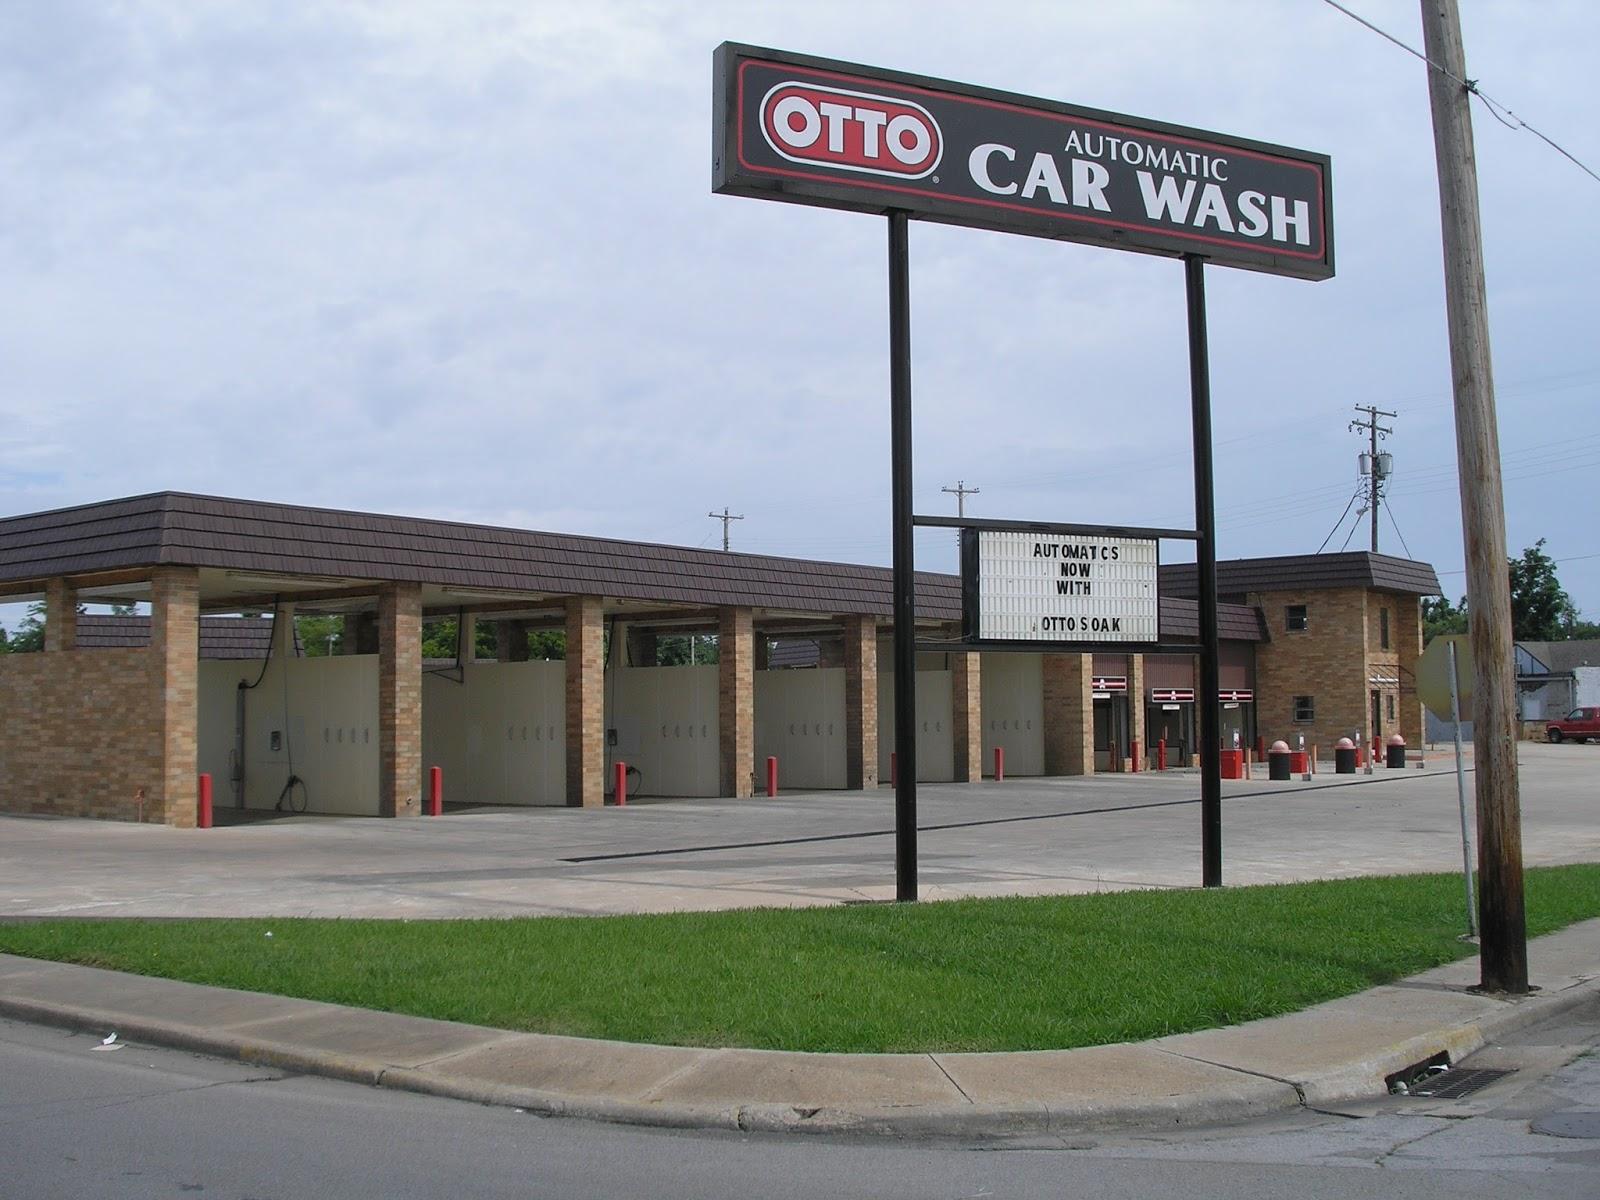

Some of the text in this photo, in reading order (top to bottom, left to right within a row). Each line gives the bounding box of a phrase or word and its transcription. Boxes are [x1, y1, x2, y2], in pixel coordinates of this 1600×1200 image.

[772, 96, 931, 165] OTTO
[1064, 130, 1229, 181] AUTOMATIC
[968, 143, 1311, 246] CAR WASH
[1056, 580, 1091, 595] WITH
[1060, 562, 1091, 577] NOW
